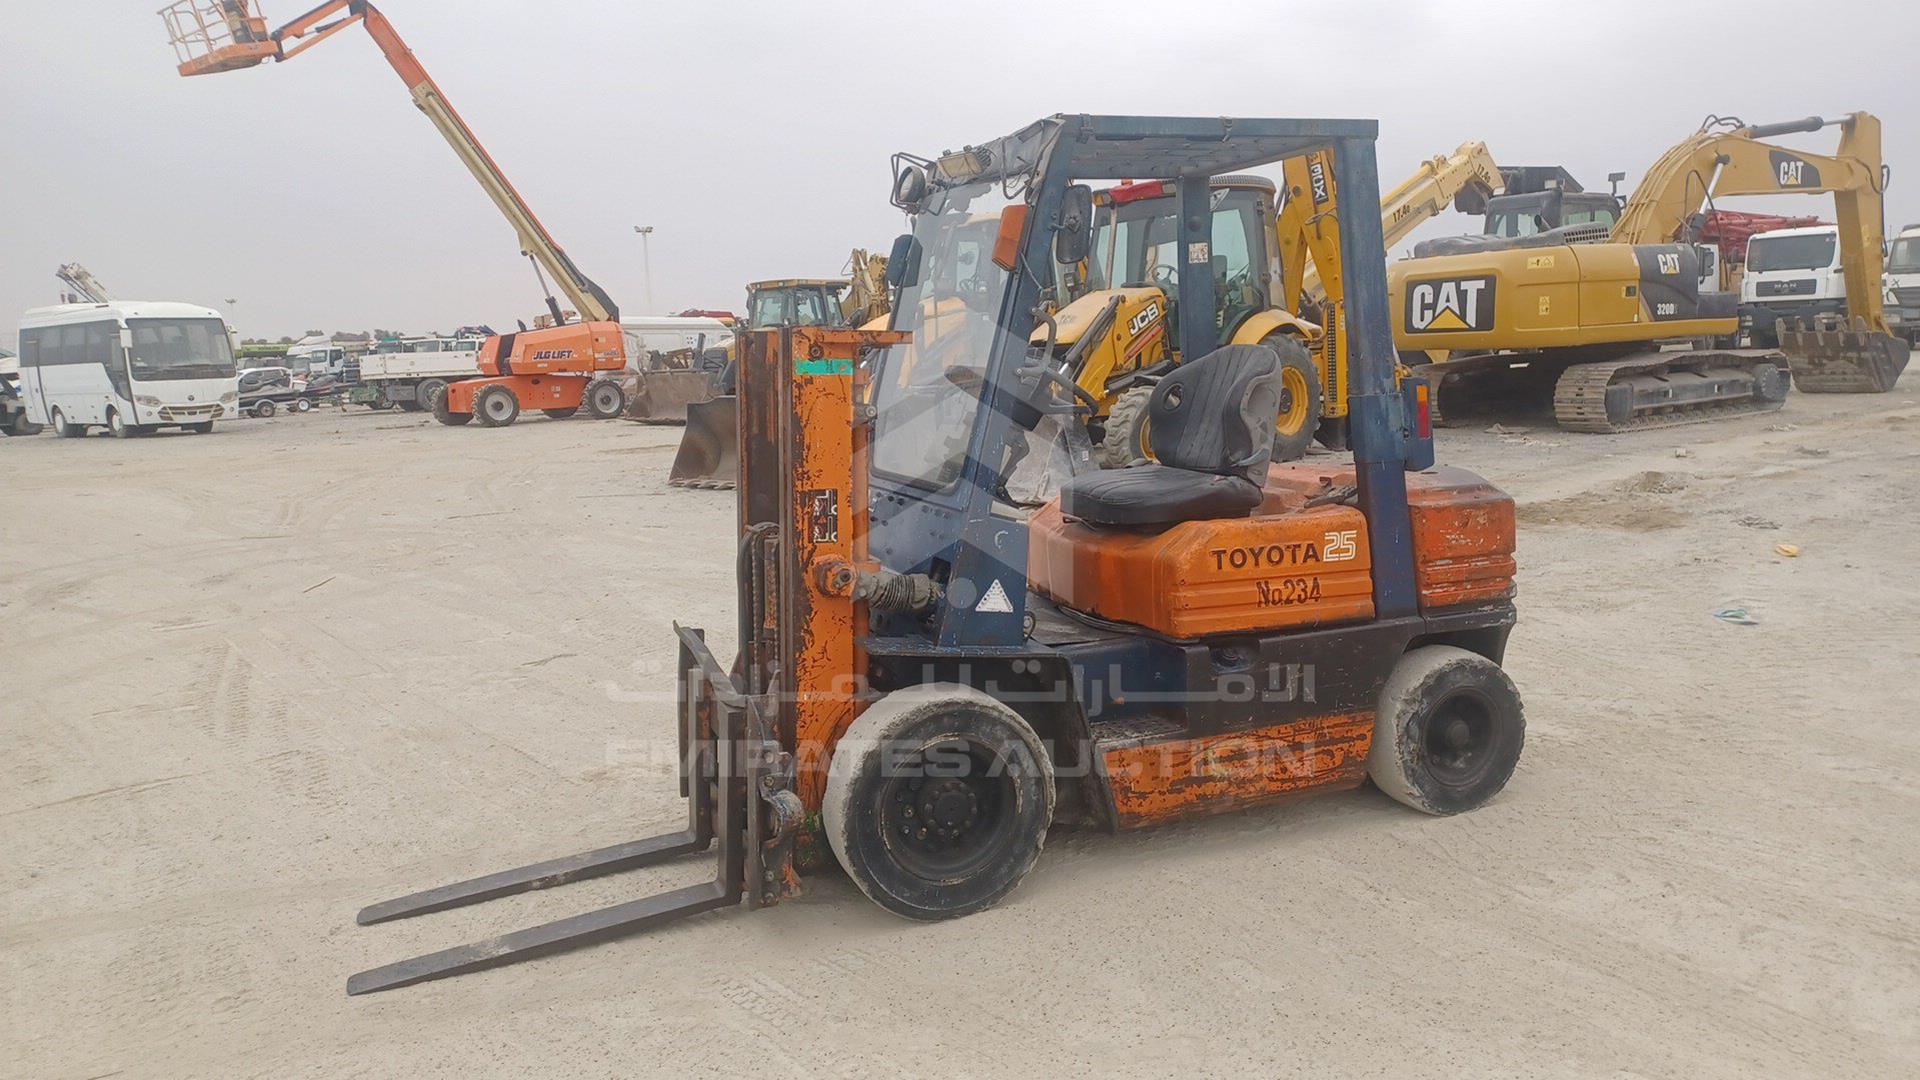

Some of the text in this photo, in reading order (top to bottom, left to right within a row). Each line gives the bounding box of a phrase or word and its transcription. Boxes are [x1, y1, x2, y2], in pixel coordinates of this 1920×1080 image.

[1311, 163, 1326, 198] 3CX
[1780, 161, 1804, 185] CAT
[1657, 253, 1680, 274] CAT
[1130, 303, 1159, 335] JCB
[1412, 279, 1486, 330] CAT
[533, 350, 573, 360] JLG LIFT
[1210, 530, 1358, 570] TOYOTA 25
[1256, 577, 1322, 608] No.234
